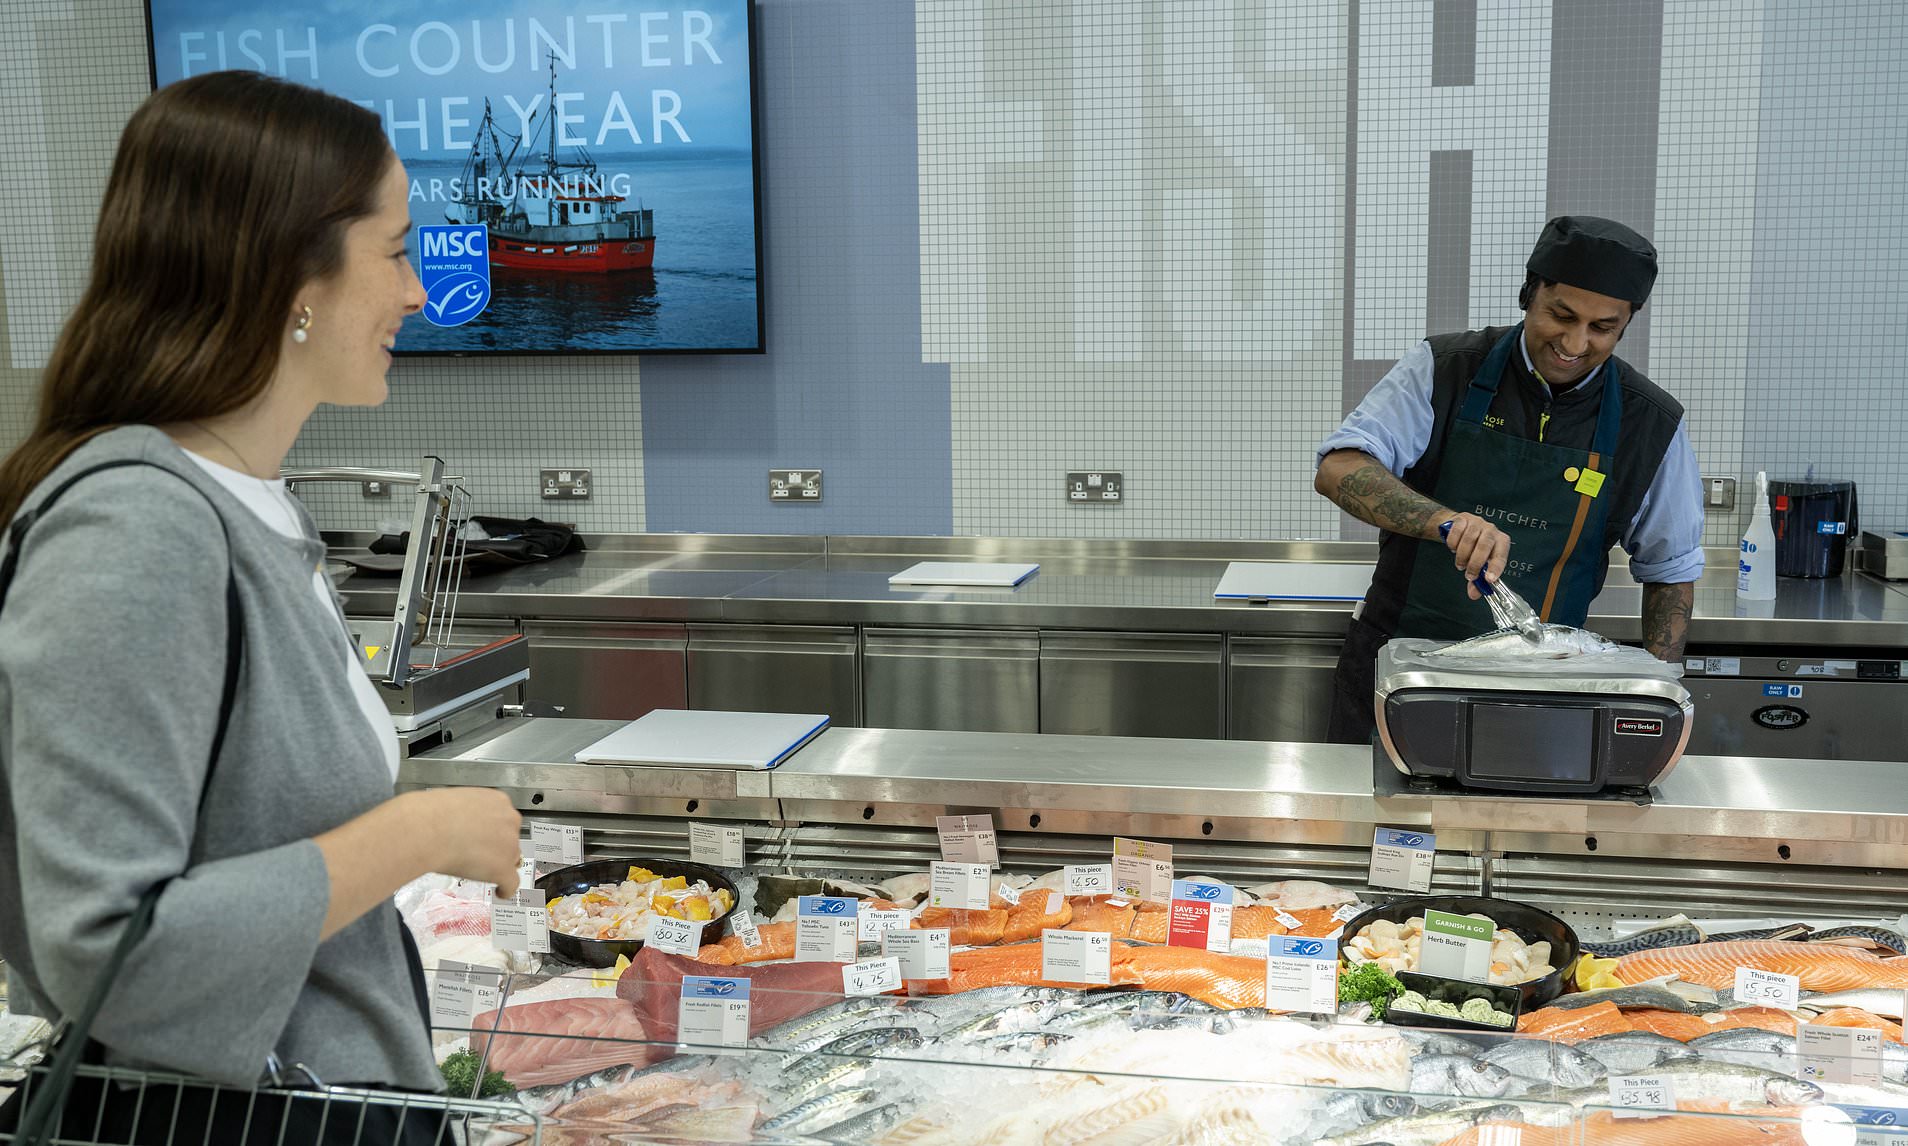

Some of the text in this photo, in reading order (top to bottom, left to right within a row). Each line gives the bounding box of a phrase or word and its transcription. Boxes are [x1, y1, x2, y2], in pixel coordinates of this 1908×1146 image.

[179, 10, 723, 80] FISH COUNTER
[360, 89, 692, 151] HE YEAR
[408, 173, 632, 202] ARS RUNNING
[423, 231, 483, 257] MSC
[424, 263, 472, 272] www.msc.org
[1475, 505, 1548, 530] BUTCHER
[1761, 712, 1800, 723] FOSTER
[1621, 722, 1655, 731] Avery Berkel
[1130, 851, 1154, 859] ORGANIC
[1088, 866, 1102, 875] piece
[883, 912, 900, 921] piece
[1174, 905, 1209, 916] SAVE 25%
[661, 918, 691, 930] This Piece
[1435, 919, 1465, 931] GARNISH
[1428, 935, 1466, 948] Herb Butter
[1751, 971, 1786, 984] This piece
[1640, 1078, 1660, 1086] Piece
